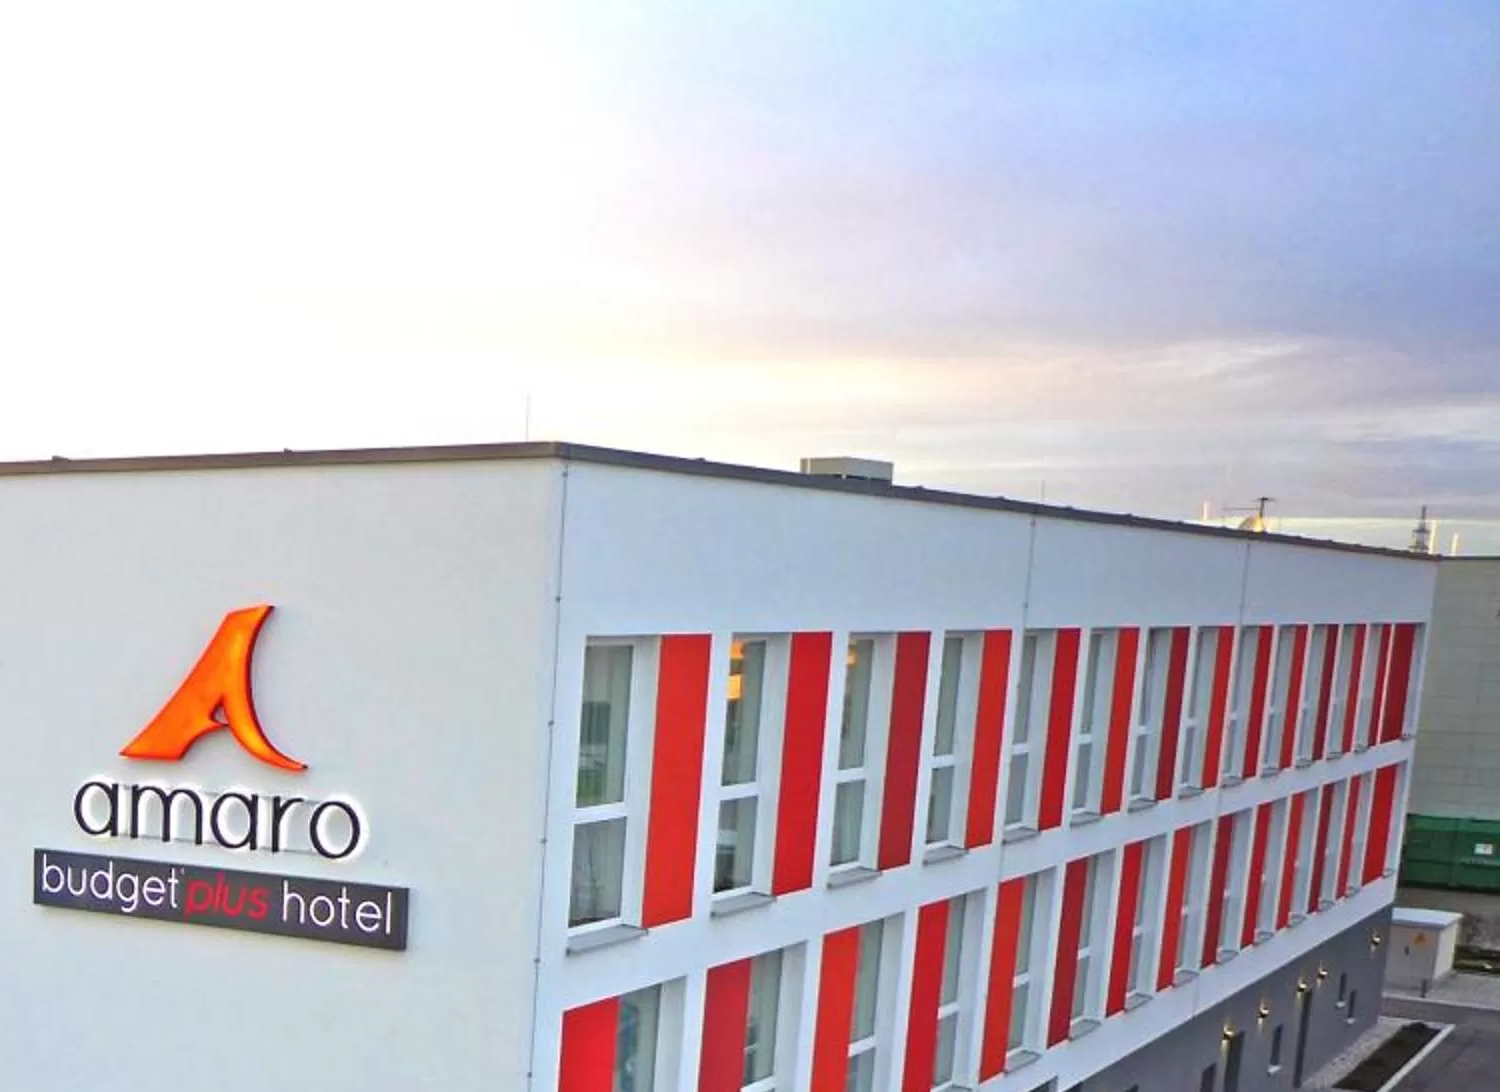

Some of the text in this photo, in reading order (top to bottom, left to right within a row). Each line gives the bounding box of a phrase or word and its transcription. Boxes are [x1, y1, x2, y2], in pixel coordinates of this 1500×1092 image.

[74, 781, 361, 859] amaro
[41, 853, 392, 935] budget plus hotel
